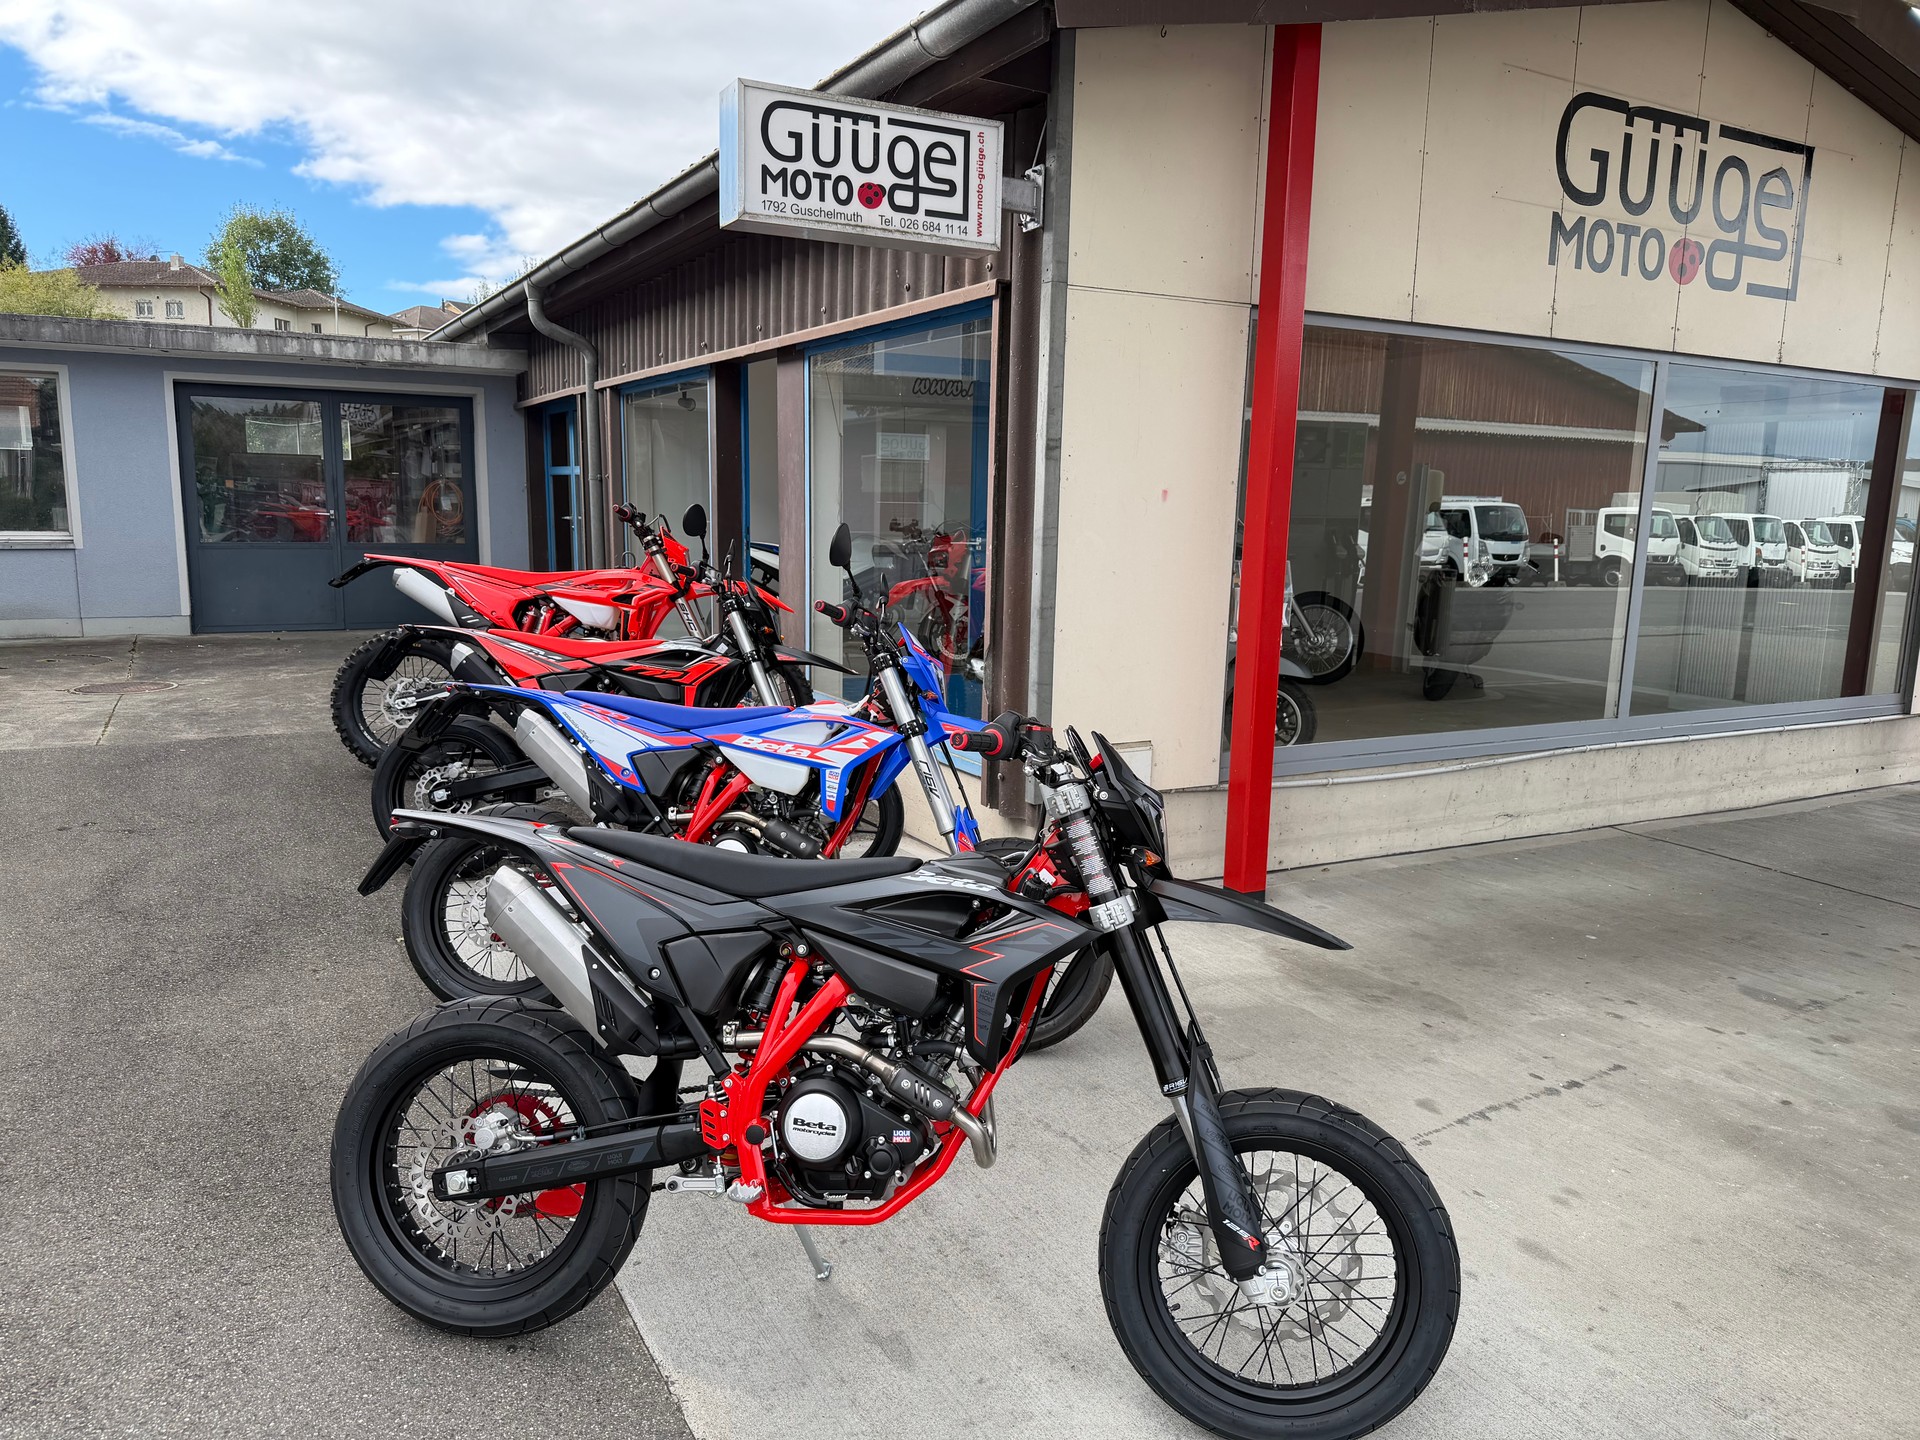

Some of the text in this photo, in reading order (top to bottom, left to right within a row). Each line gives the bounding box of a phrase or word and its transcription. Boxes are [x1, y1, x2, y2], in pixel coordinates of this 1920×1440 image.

[761, 164, 854, 206] MOTO
[976, 131, 986, 238] www.moto-güüge.ch
[761, 200, 968, 236] 1792 Guschelmuth Tel. 026 684 11 14
[1548, 211, 1666, 281] MOTO
[732, 735, 812, 758] Beta
[792, 1127, 836, 1136] motorcycles
[793, 1117, 837, 1131] Beta
